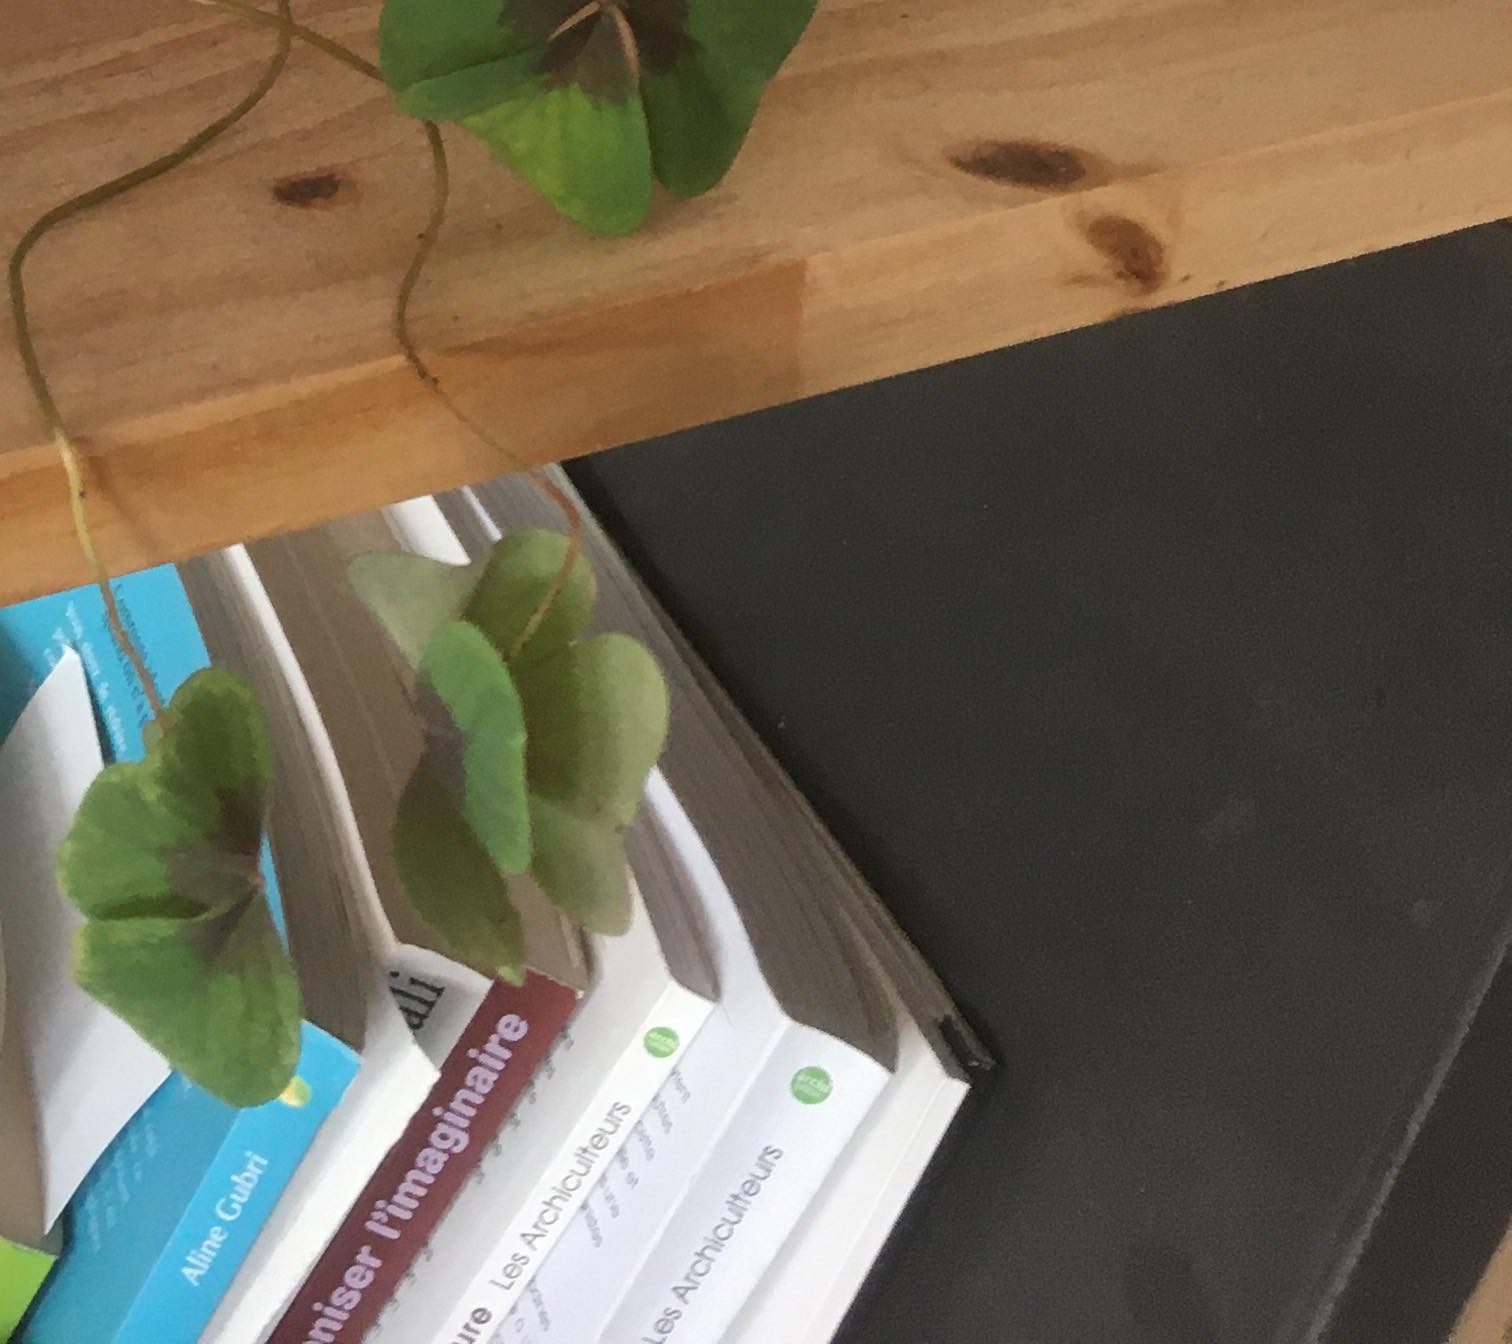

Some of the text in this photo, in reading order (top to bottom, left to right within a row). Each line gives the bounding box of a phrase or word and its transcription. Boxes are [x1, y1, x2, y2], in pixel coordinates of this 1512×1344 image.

[180, 1150, 269, 1287] Aline Gubri
[301, 1010, 530, 1344] niser l'imaginaire
[490, 1248, 531, 1291] Les
[523, 1099, 633, 1262] Archiculteurs
[640, 1142, 785, 1344] Les Archiculteurs
